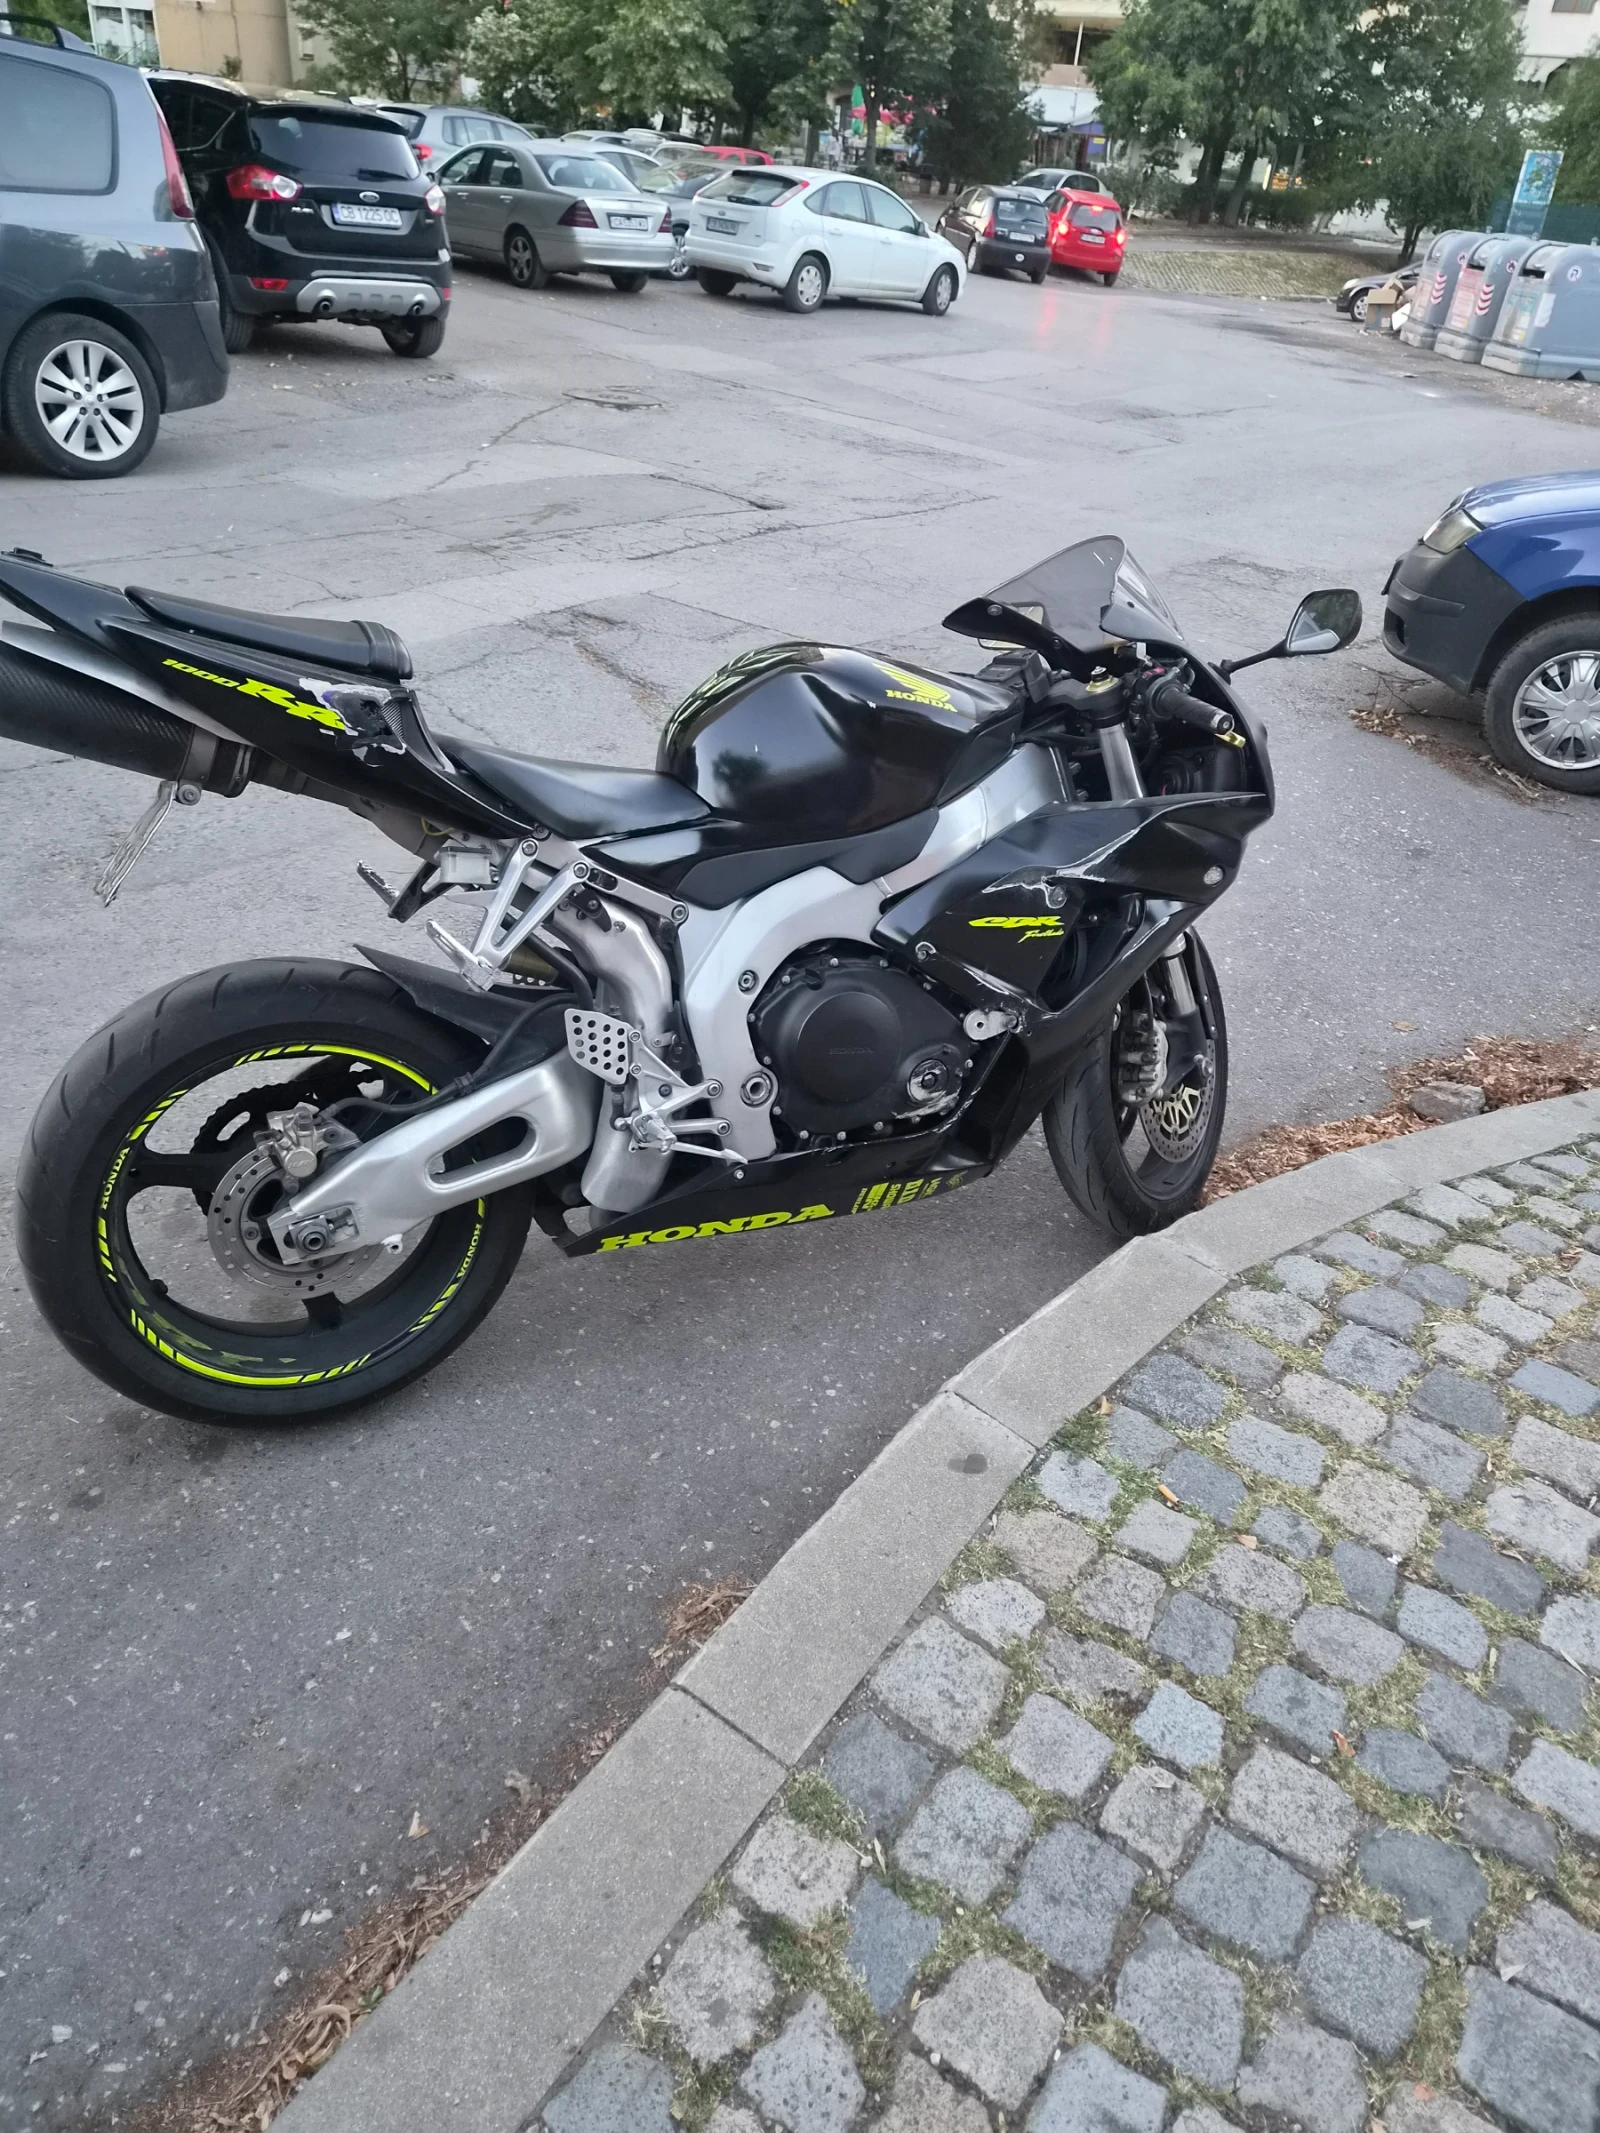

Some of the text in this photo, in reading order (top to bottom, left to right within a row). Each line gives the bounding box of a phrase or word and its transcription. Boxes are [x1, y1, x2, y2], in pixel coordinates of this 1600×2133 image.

[340, 205, 356, 220] CB
[357, 206, 384, 222] 1225
[885, 689, 958, 712] HONDA
[968, 916, 1065, 928] CBR
[829, 1046, 874, 1055] HONDA
[101, 1147, 130, 1210] HONDA
[596, 1203, 836, 1253] HONDA
[457, 1223, 482, 1278] HONDA
